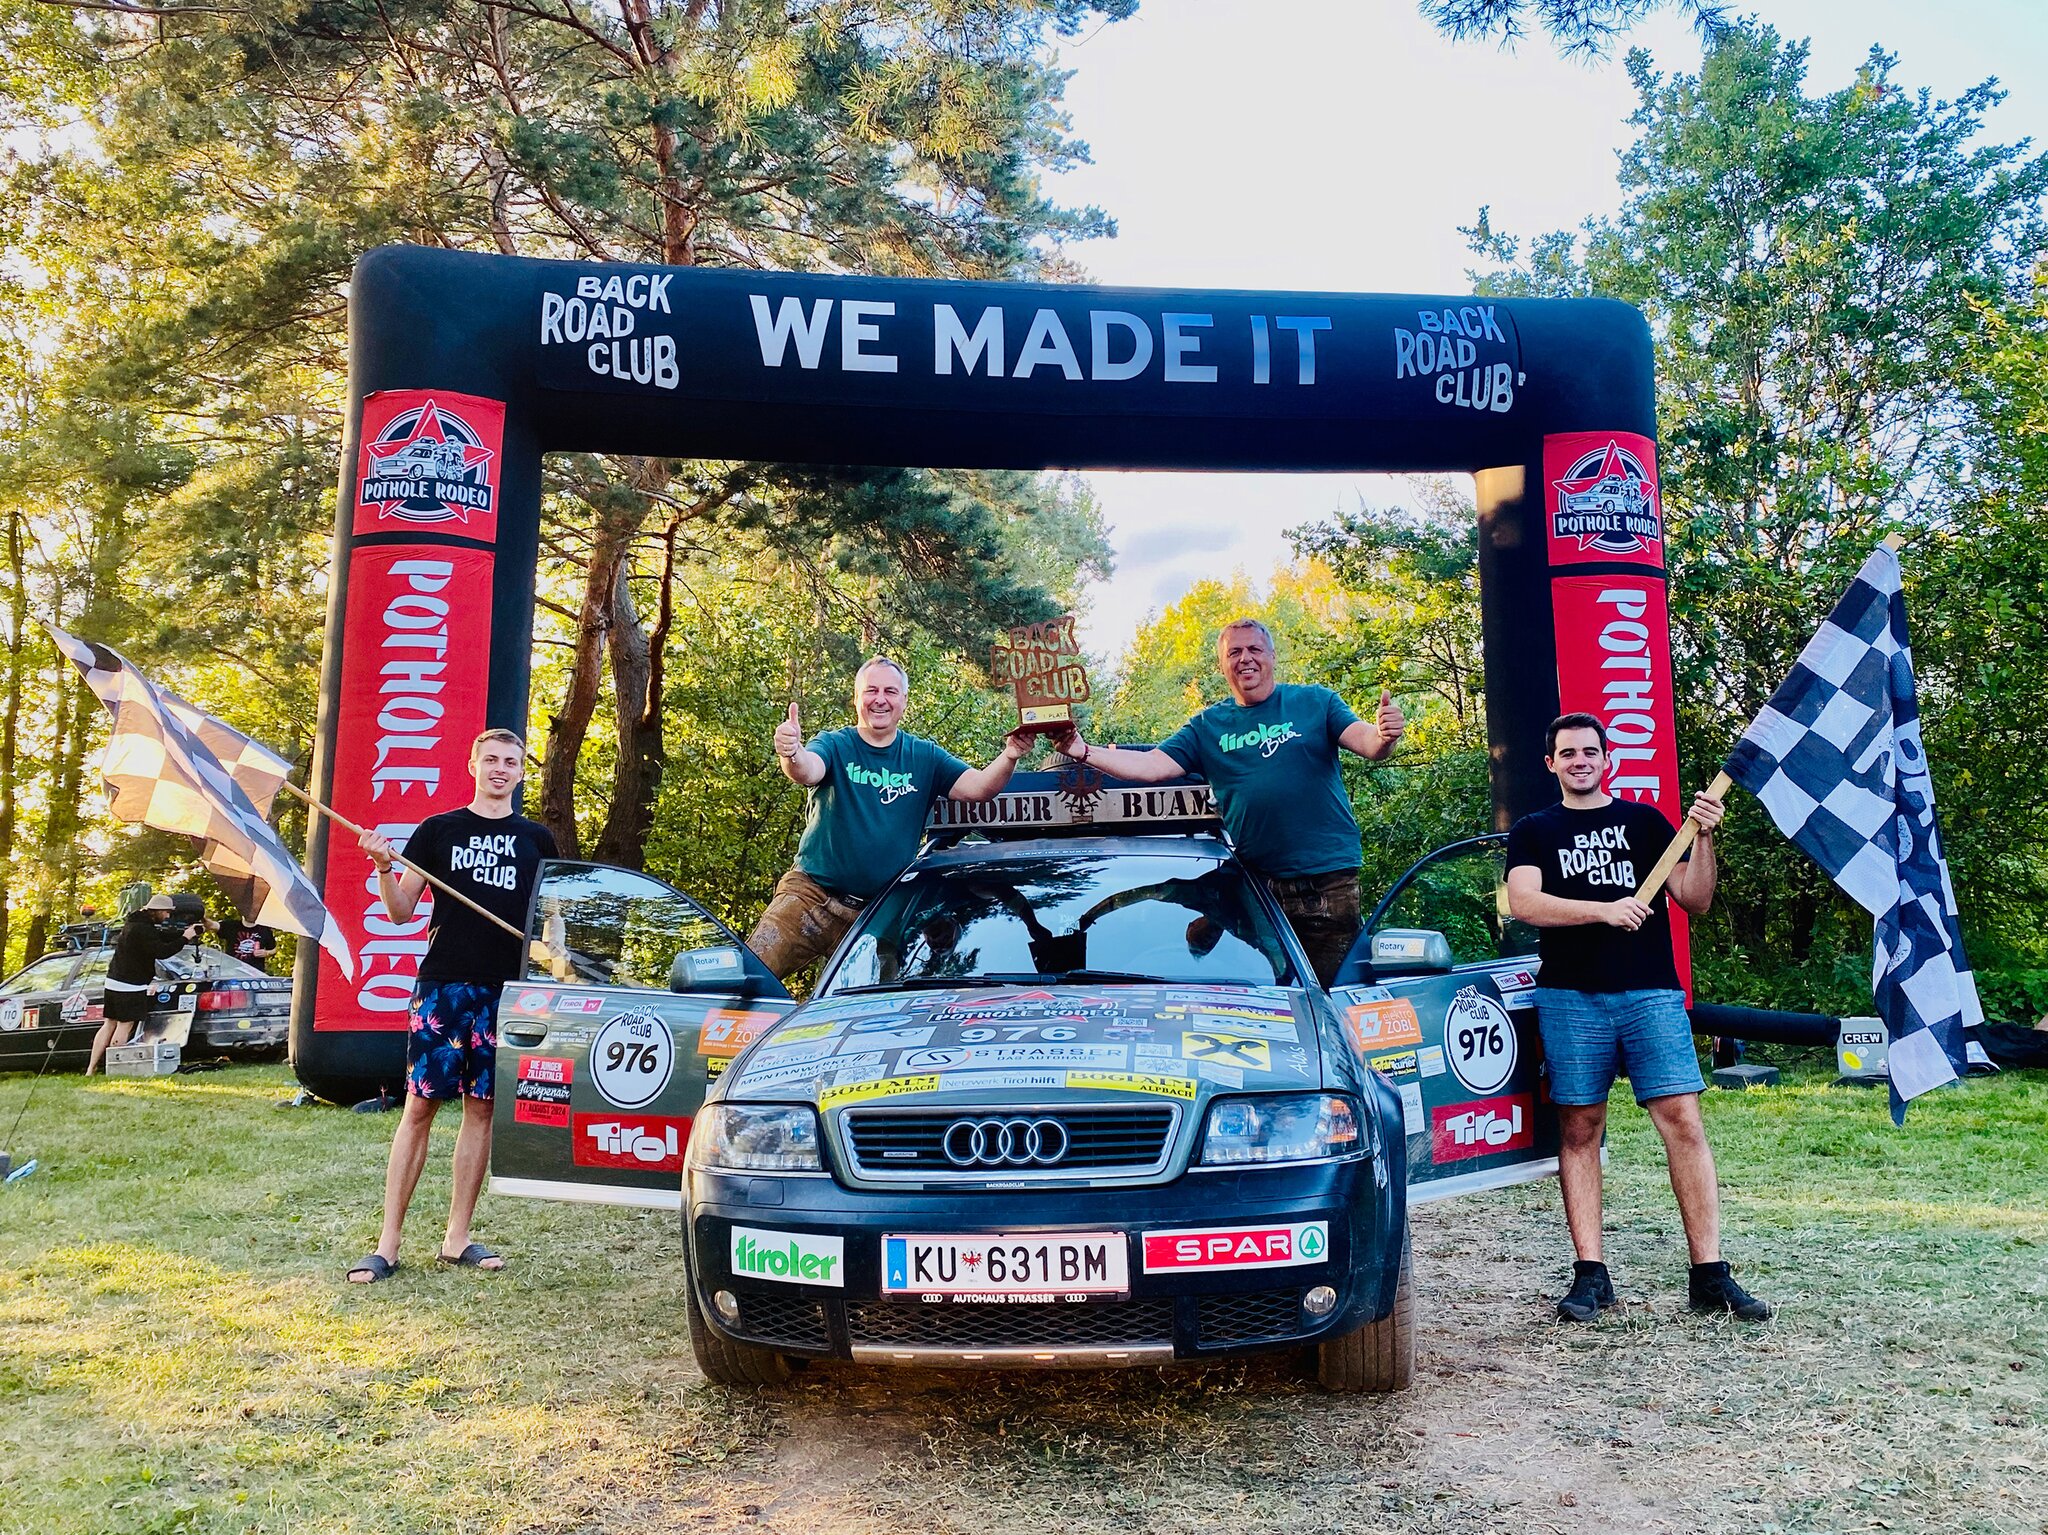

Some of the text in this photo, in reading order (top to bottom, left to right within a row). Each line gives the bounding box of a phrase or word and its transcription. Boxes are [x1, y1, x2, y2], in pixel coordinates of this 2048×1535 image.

[577, 273, 674, 314] BACK
[541, 291, 636, 345] ROAD
[1417, 305, 1506, 344] BACK
[749, 294, 1333, 386] WE MADE IT
[1394, 327, 1477, 379] ROAD
[587, 334, 680, 390] CLUB
[1435, 362, 1514, 413] CLUB
[364, 480, 488, 507] POTHOLE RODEO
[1557, 514, 1657, 537] POTHOLE RODEO
[1012, 619, 1074, 652] BACK
[994, 649, 1056, 681] ROAD
[371, 559, 454, 803] POTHOLE
[1026, 667, 1088, 700] CLUB
[1219, 721, 1294, 753] tiroler
[1259, 730, 1302, 758] Bua
[846, 762, 913, 789] tiroler
[878, 784, 918, 804] Bua
[932, 788, 1216, 826] TIROLER BUAM
[469, 834, 517, 858] BACK
[1573, 825, 1631, 850] BACK
[451, 845, 498, 871] ROAD
[1557, 848, 1612, 879] ROAD
[472, 865, 517, 891] CLUB
[1588, 860, 1637, 889] CLUB
[1379, 942, 1406, 951] Rotary
[695, 957, 720, 966] Rotary
[1458, 985, 1482, 1000] BACK
[1500, 976, 1517, 985] TIROL
[4, 1009, 17, 1020] 110
[633, 1004, 660, 1018] BACK
[934, 1008, 1119, 1022] POTHOLE RODEO
[1382, 1010, 1413, 1021] elektro
[1455, 998, 1478, 1014] ROAD
[1469, 1005, 1490, 1020] CLUB
[620, 1012, 645, 1027] ROAD
[630, 1024, 653, 1039] CLUB
[1384, 1019, 1416, 1034] ZOBL
[959, 1026, 1078, 1043] 976
[1458, 1023, 1504, 1062] 976
[1844, 1033, 1880, 1044] CREW
[606, 1041, 659, 1074] 976
[974, 1048, 1122, 1058] STRASSER
[527, 1069, 564, 1082] ZILLERTALER
[530, 1060, 563, 1073] DIE JUNGEN
[740, 1058, 847, 1086] MONTANWERKE
[884, 1084, 935, 1096] ALPBACH
[944, 1076, 1056, 1087] Netzwerk Tirol hilft
[1139, 1085, 1193, 1097] ALPBACH
[528, 1103, 551, 1114] AUGUST
[551, 1105, 566, 1116] 2024
[1445, 1104, 1523, 1146] Tirol
[586, 1121, 679, 1162] Tirol
[735, 1234, 837, 1281] tiroler
[1176, 1234, 1290, 1262] SPAR
[892, 1269, 902, 1282] A
[914, 1246, 957, 1283] KU
[952, 1293, 1056, 1304] AUTOHAUS STRASSER
